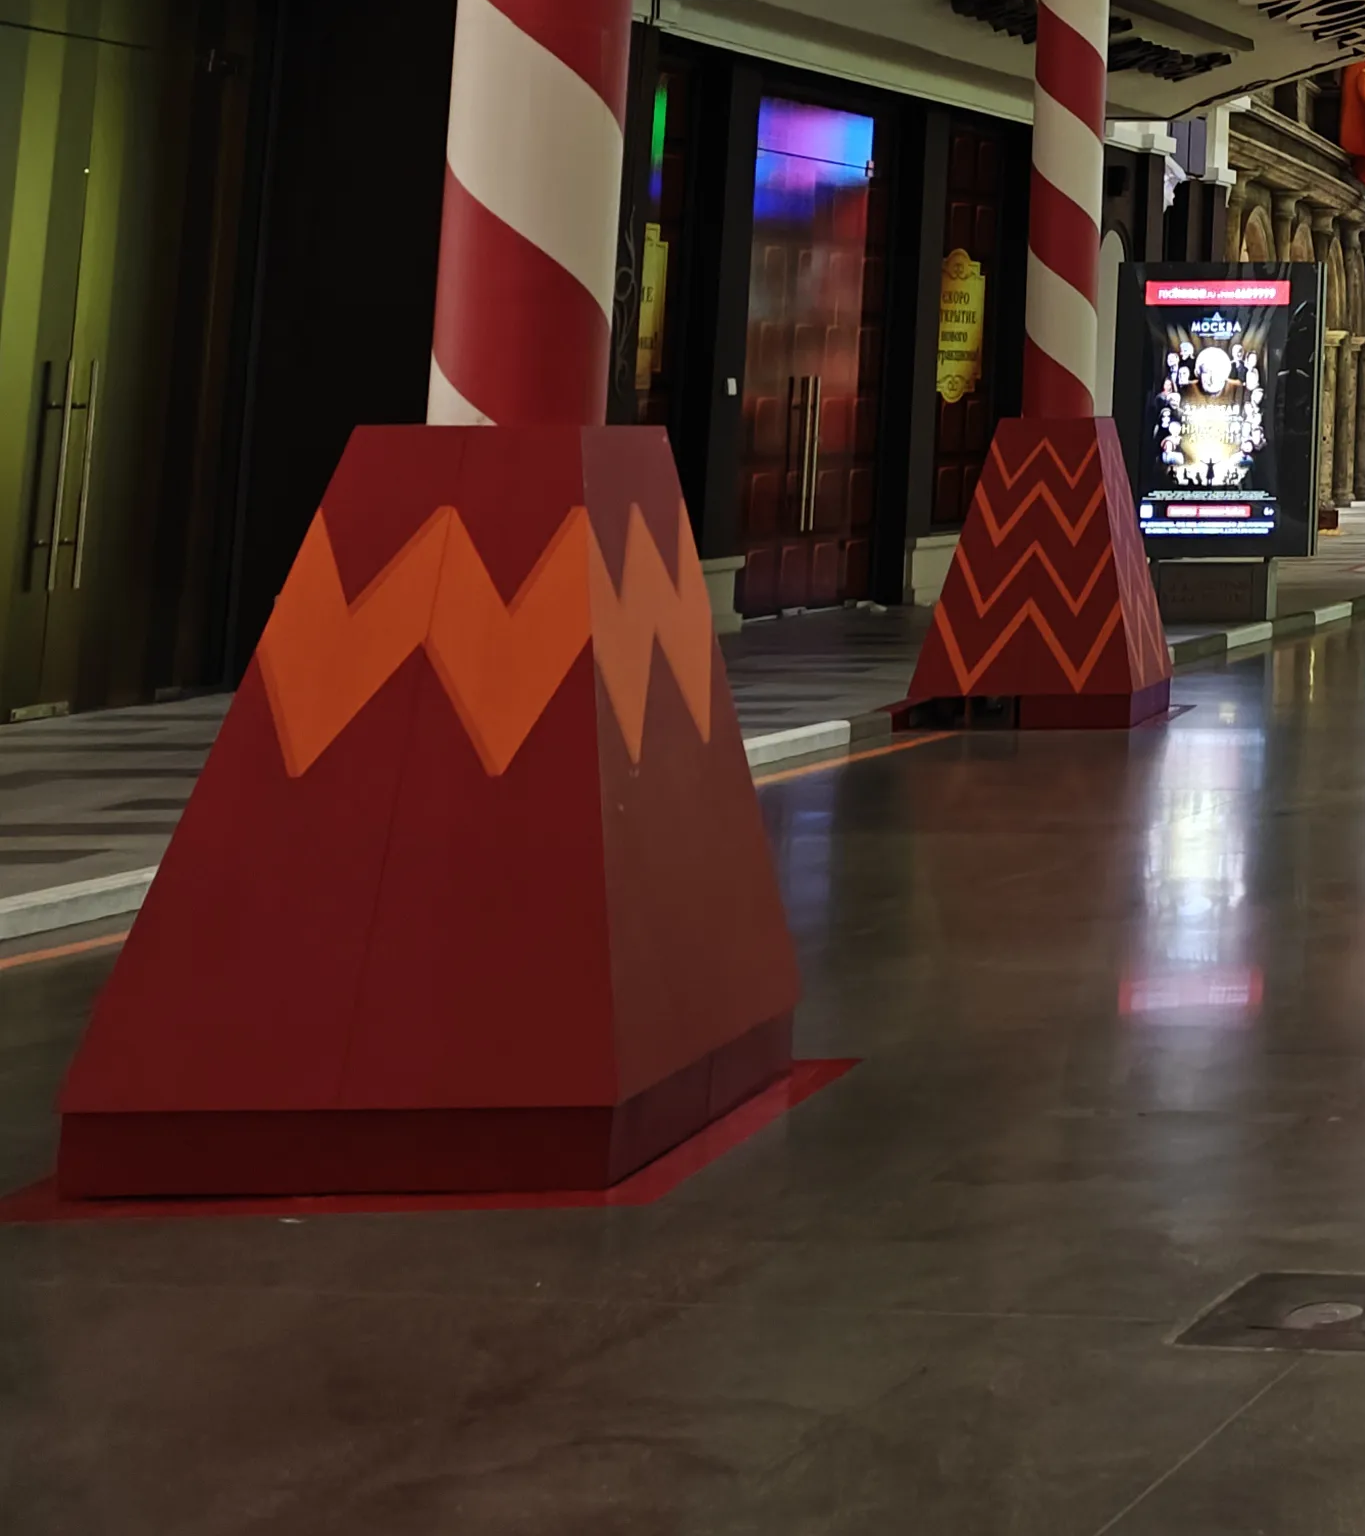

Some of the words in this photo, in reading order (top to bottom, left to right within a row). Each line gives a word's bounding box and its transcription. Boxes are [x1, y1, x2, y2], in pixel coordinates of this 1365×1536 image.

[942, 291, 970, 305] СКОРО
[940, 309, 977, 324] ТКРЫТИЕ
[1191, 321, 1242, 333] МОСКВА
